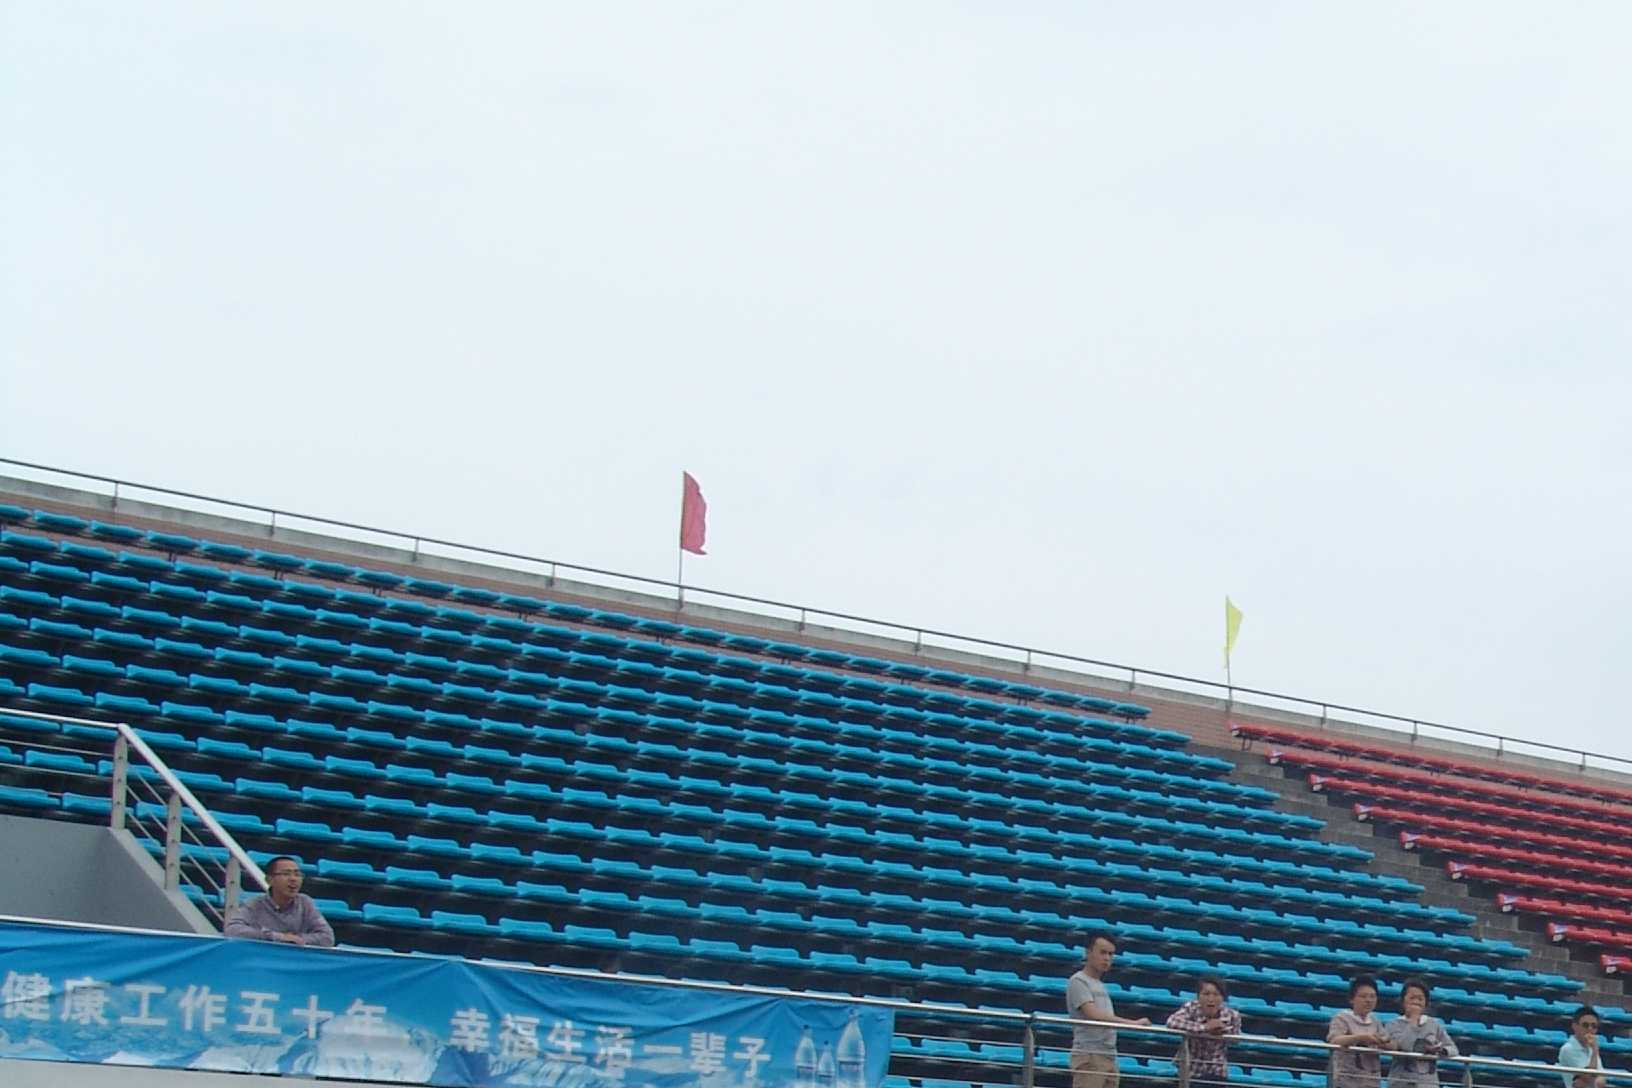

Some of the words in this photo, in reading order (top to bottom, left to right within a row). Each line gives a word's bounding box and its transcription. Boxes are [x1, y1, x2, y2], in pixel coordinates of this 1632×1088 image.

[2, 970, 387, 1044] 健康工作五十年
[449, 1008, 771, 1079] 幸福生活一辈子
